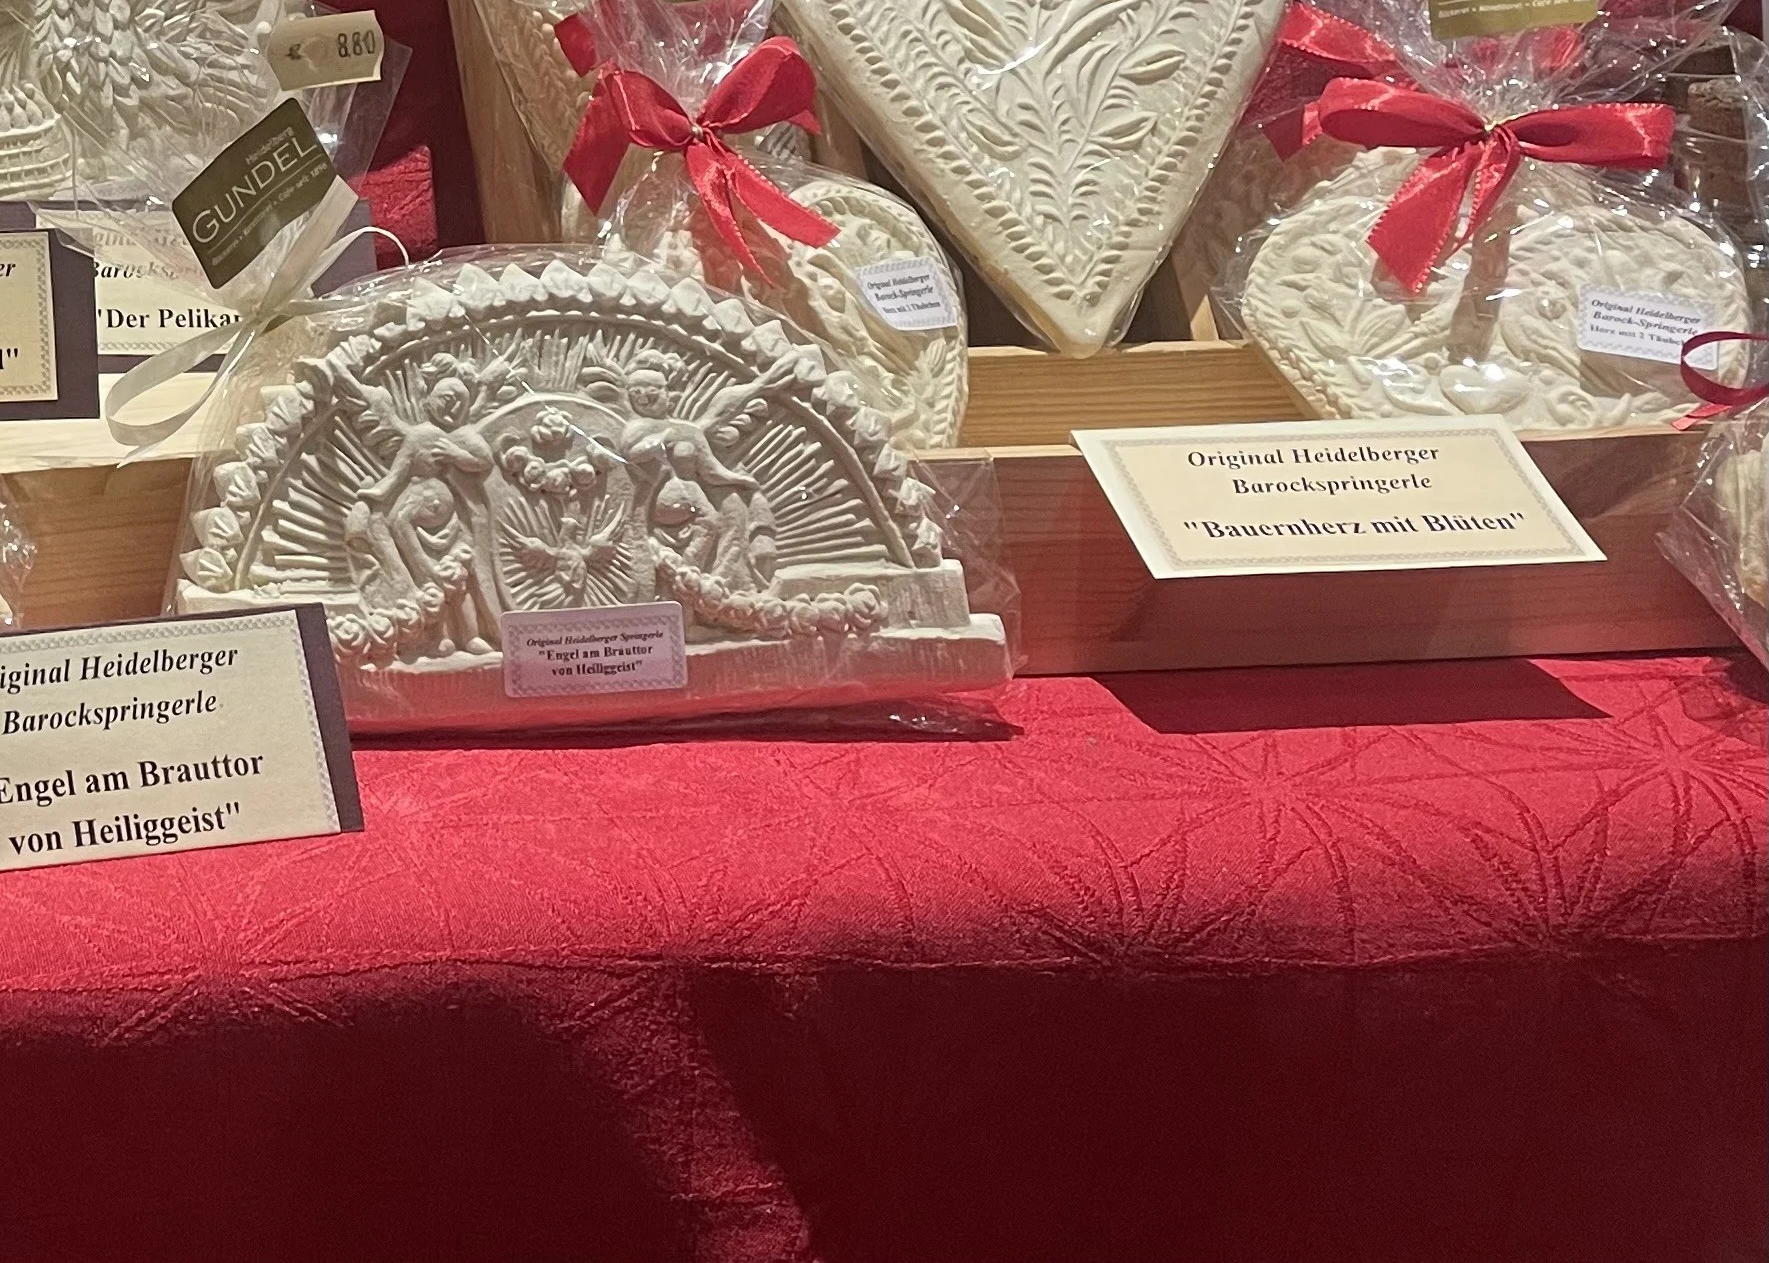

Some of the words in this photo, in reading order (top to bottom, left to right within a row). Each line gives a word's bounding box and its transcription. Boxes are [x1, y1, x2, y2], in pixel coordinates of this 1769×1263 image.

[191, 136, 318, 244] GUNDEL
[1591, 298, 1634, 313] Original
[1636, 306, 1702, 325] Heidelberger
[1187, 447, 1285, 471] Original
[1293, 445, 1441, 469] Heidelberger
[1231, 472, 1433, 497] Barockspringerle
[1182, 517, 1367, 540] "Bauernherz
[1373, 515, 1420, 536] mit
[1425, 510, 1526, 534] Blüten"
[526, 636, 563, 648] Original
[538, 648, 580, 662] "Engel
[582, 649, 600, 659] am
[603, 645, 653, 657] Brauttor
[79, 645, 239, 682] Heidelberger
[551, 666, 573, 676] von
[2, 690, 218, 737] Barockspringerle
[85, 770, 130, 793] am
[137, 751, 265, 788] Brauttor
[8, 832, 63, 857] von
[70, 801, 241, 849] Heiliggeist"
